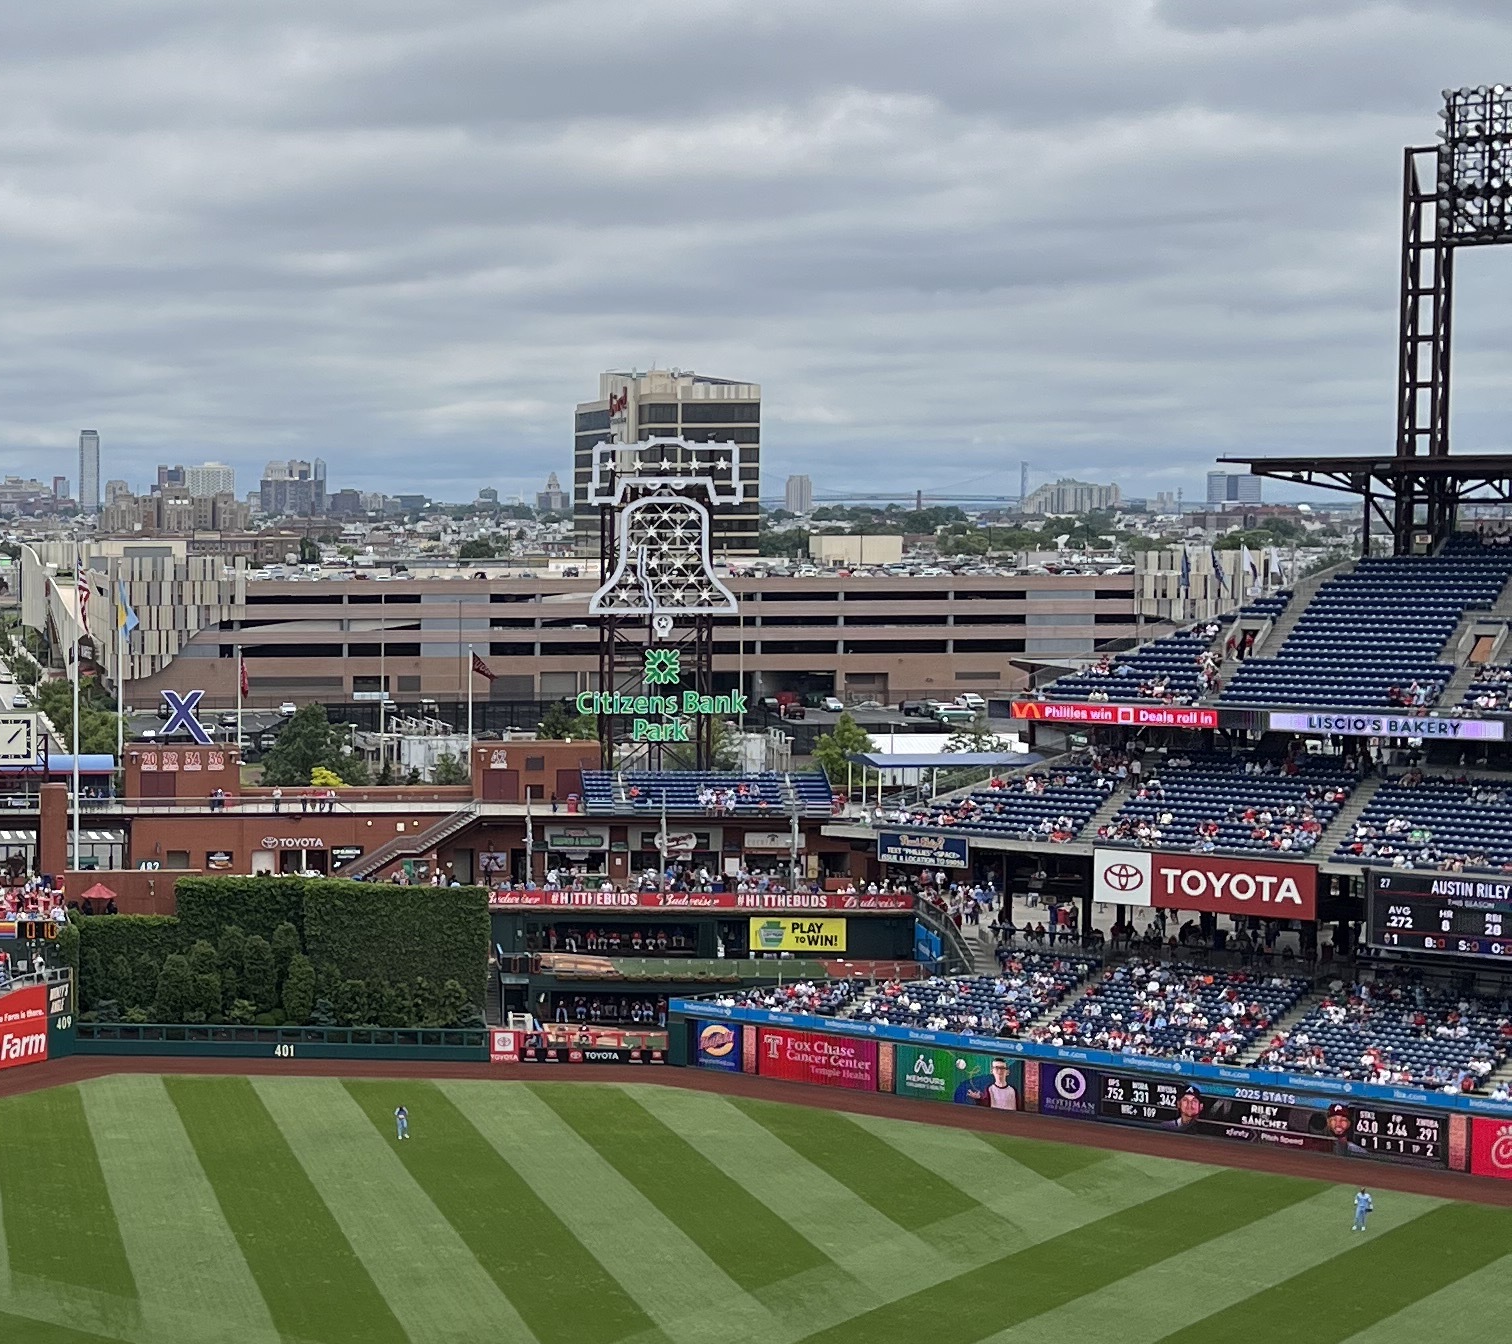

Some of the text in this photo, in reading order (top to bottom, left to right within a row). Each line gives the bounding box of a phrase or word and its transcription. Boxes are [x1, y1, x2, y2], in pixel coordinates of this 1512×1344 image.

[576, 689, 748, 715] Citizens Bank
[1044, 705, 1088, 721] Phillies
[633, 718, 689, 741] Park
[1308, 717, 1461, 735] LISCIO'S BAKERY
[279, 837, 324, 848] TOYOTA
[1160, 868, 1302, 904] TOYOTA
[1431, 879, 1510, 899] AUSTIN RILEY
[737, 892, 828, 907] #HITTHEBUDS
[1388, 906, 1411, 915] AVG
[791, 922, 824, 934] PLAY
[1386, 916, 1413, 929] .272
[807, 935, 838, 946] WIN!
[56, 1015, 72, 1030] 409
[274, 1044, 295, 1058] 401
[786, 1037, 855, 1057] Fox Chase
[585, 1051, 619, 1060] TOYOTA
[786, 1049, 872, 1070] Cancer Center
[811, 1065, 871, 1081] Temple Health
[905, 1074, 945, 1086] NEMOURS
[1289, 1077, 1342, 1089] Independence
[1104, 1087, 1149, 1104] .752 .331
[1234, 1088, 1296, 1105] 2025 STATS
[1045, 1097, 1096, 1110] ROTHMAN
[1250, 1105, 1278, 1116] RILEY
[1356, 1120, 1379, 1134] 63.0
